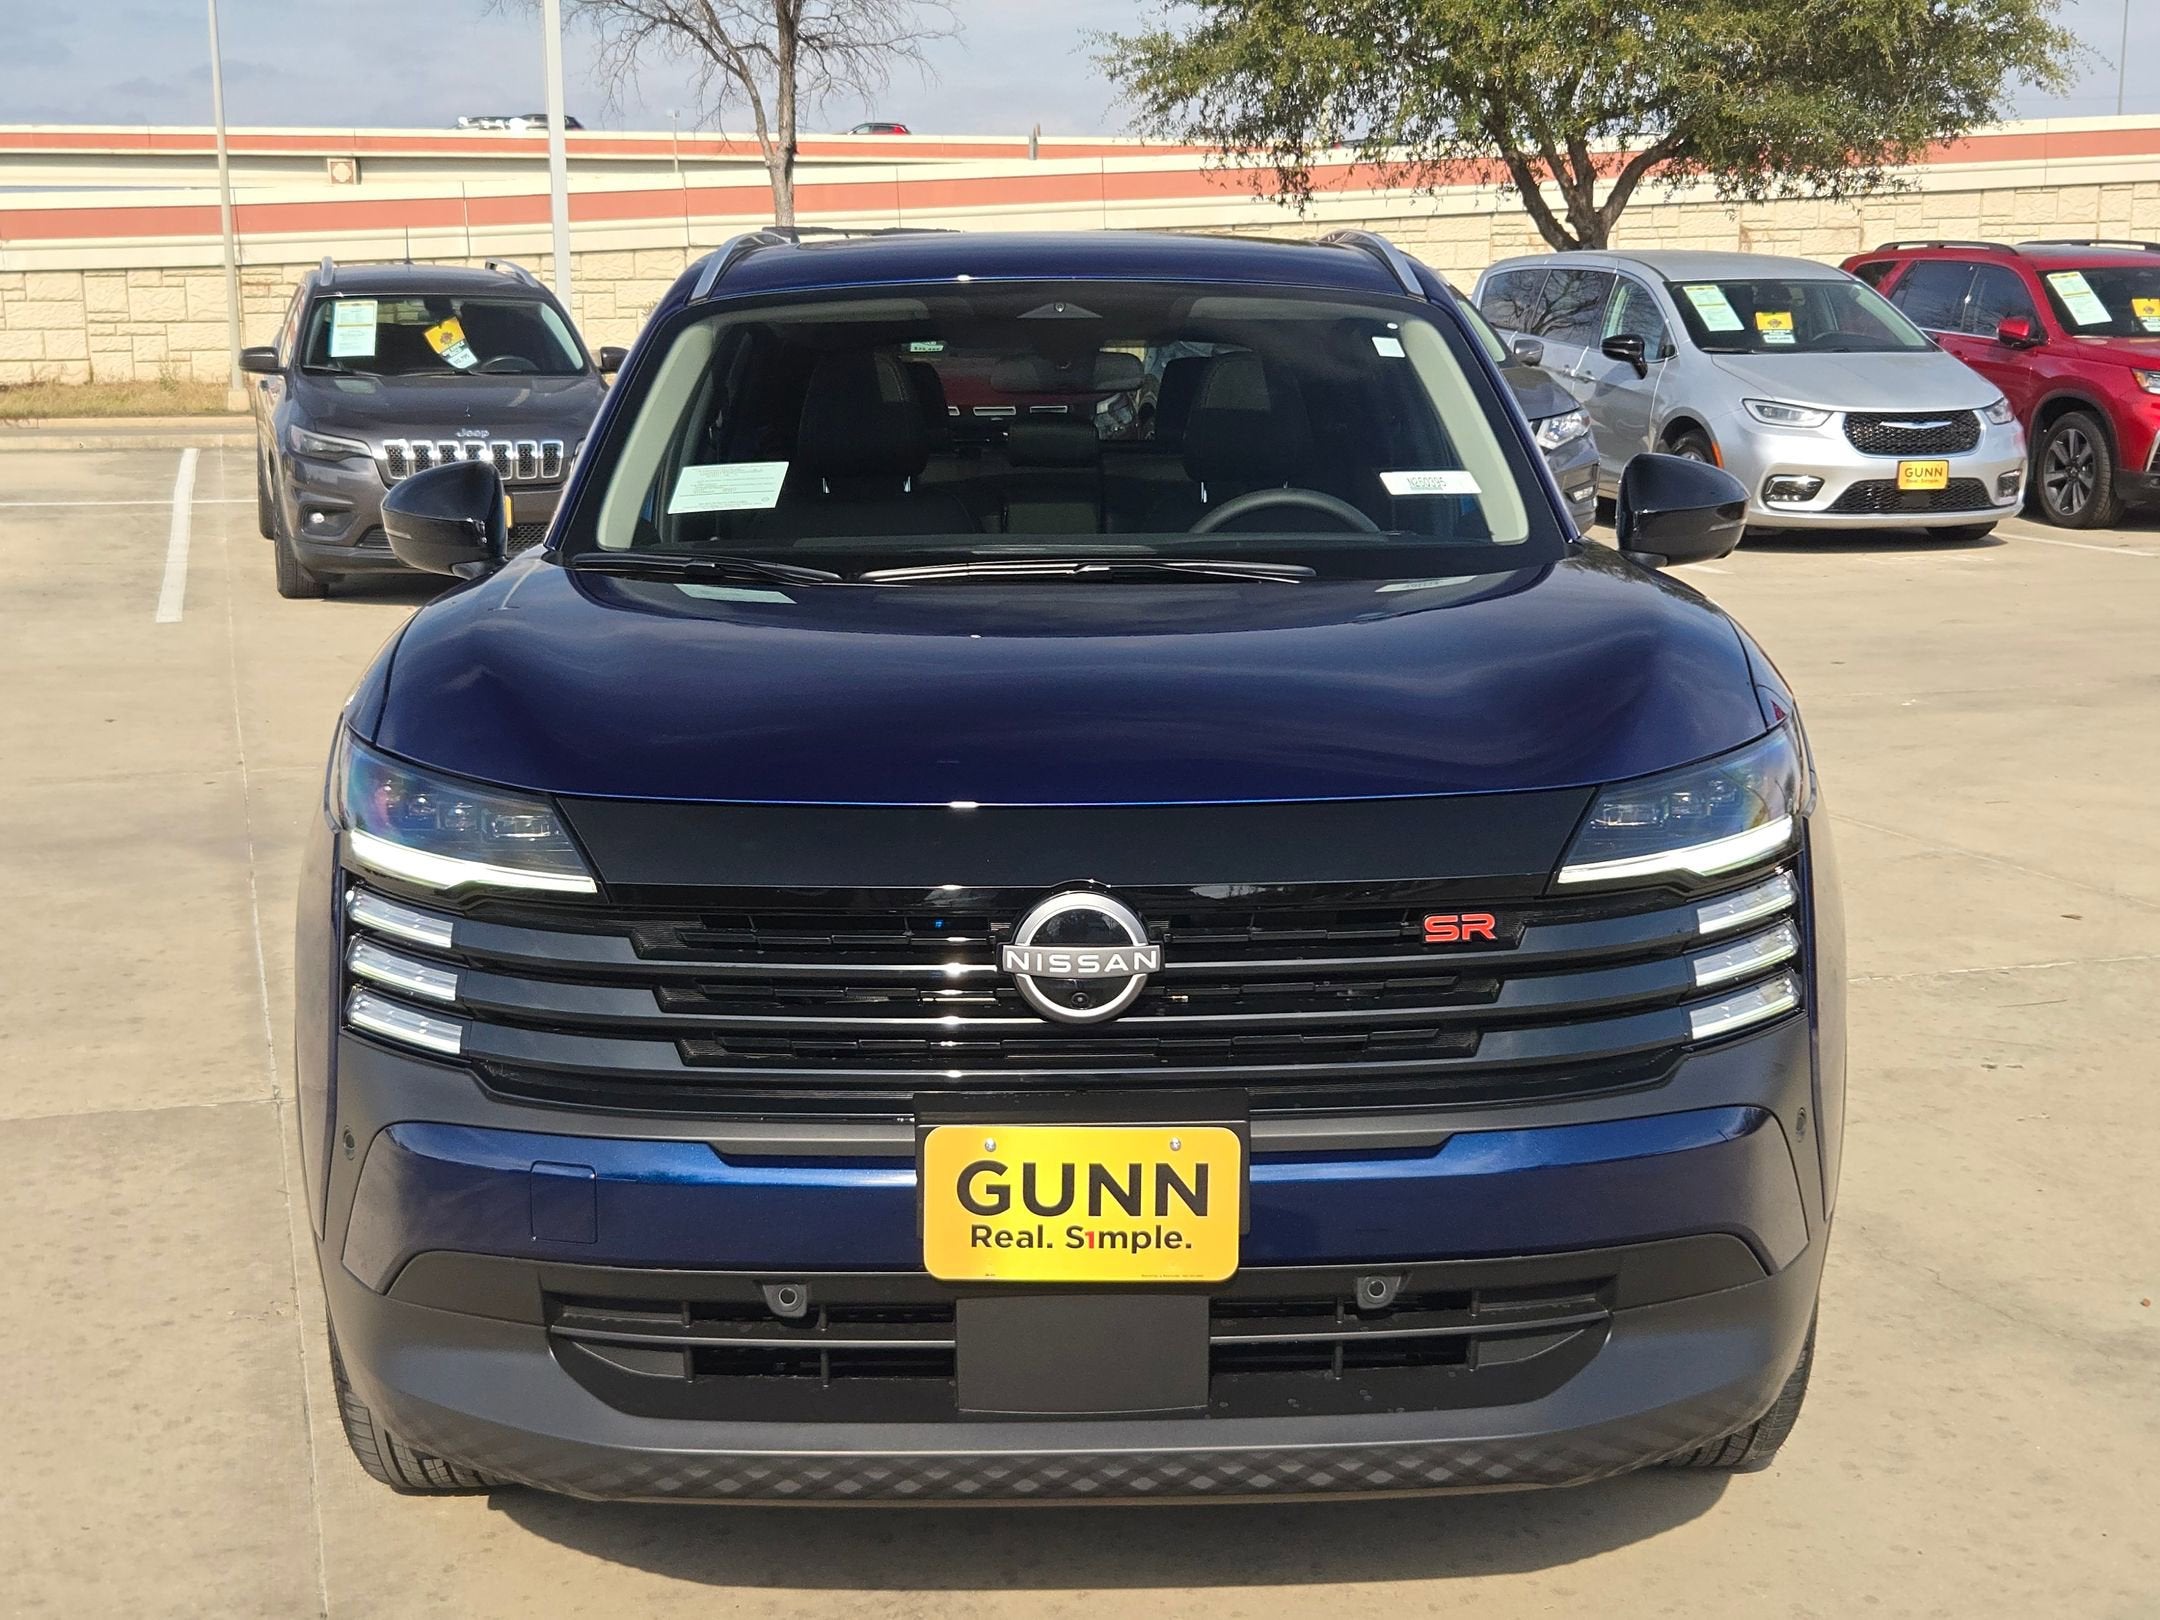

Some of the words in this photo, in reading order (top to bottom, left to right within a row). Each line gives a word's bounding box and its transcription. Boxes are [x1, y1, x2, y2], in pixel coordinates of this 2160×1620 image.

[456, 428, 490, 438] Jeep
[1904, 467, 1943, 478] GUNN
[1424, 913, 1497, 942] SR
[1006, 950, 1157, 974] NISSAN
[956, 1160, 1209, 1217] GUNN
[971, 1224, 1053, 1249] Real.
